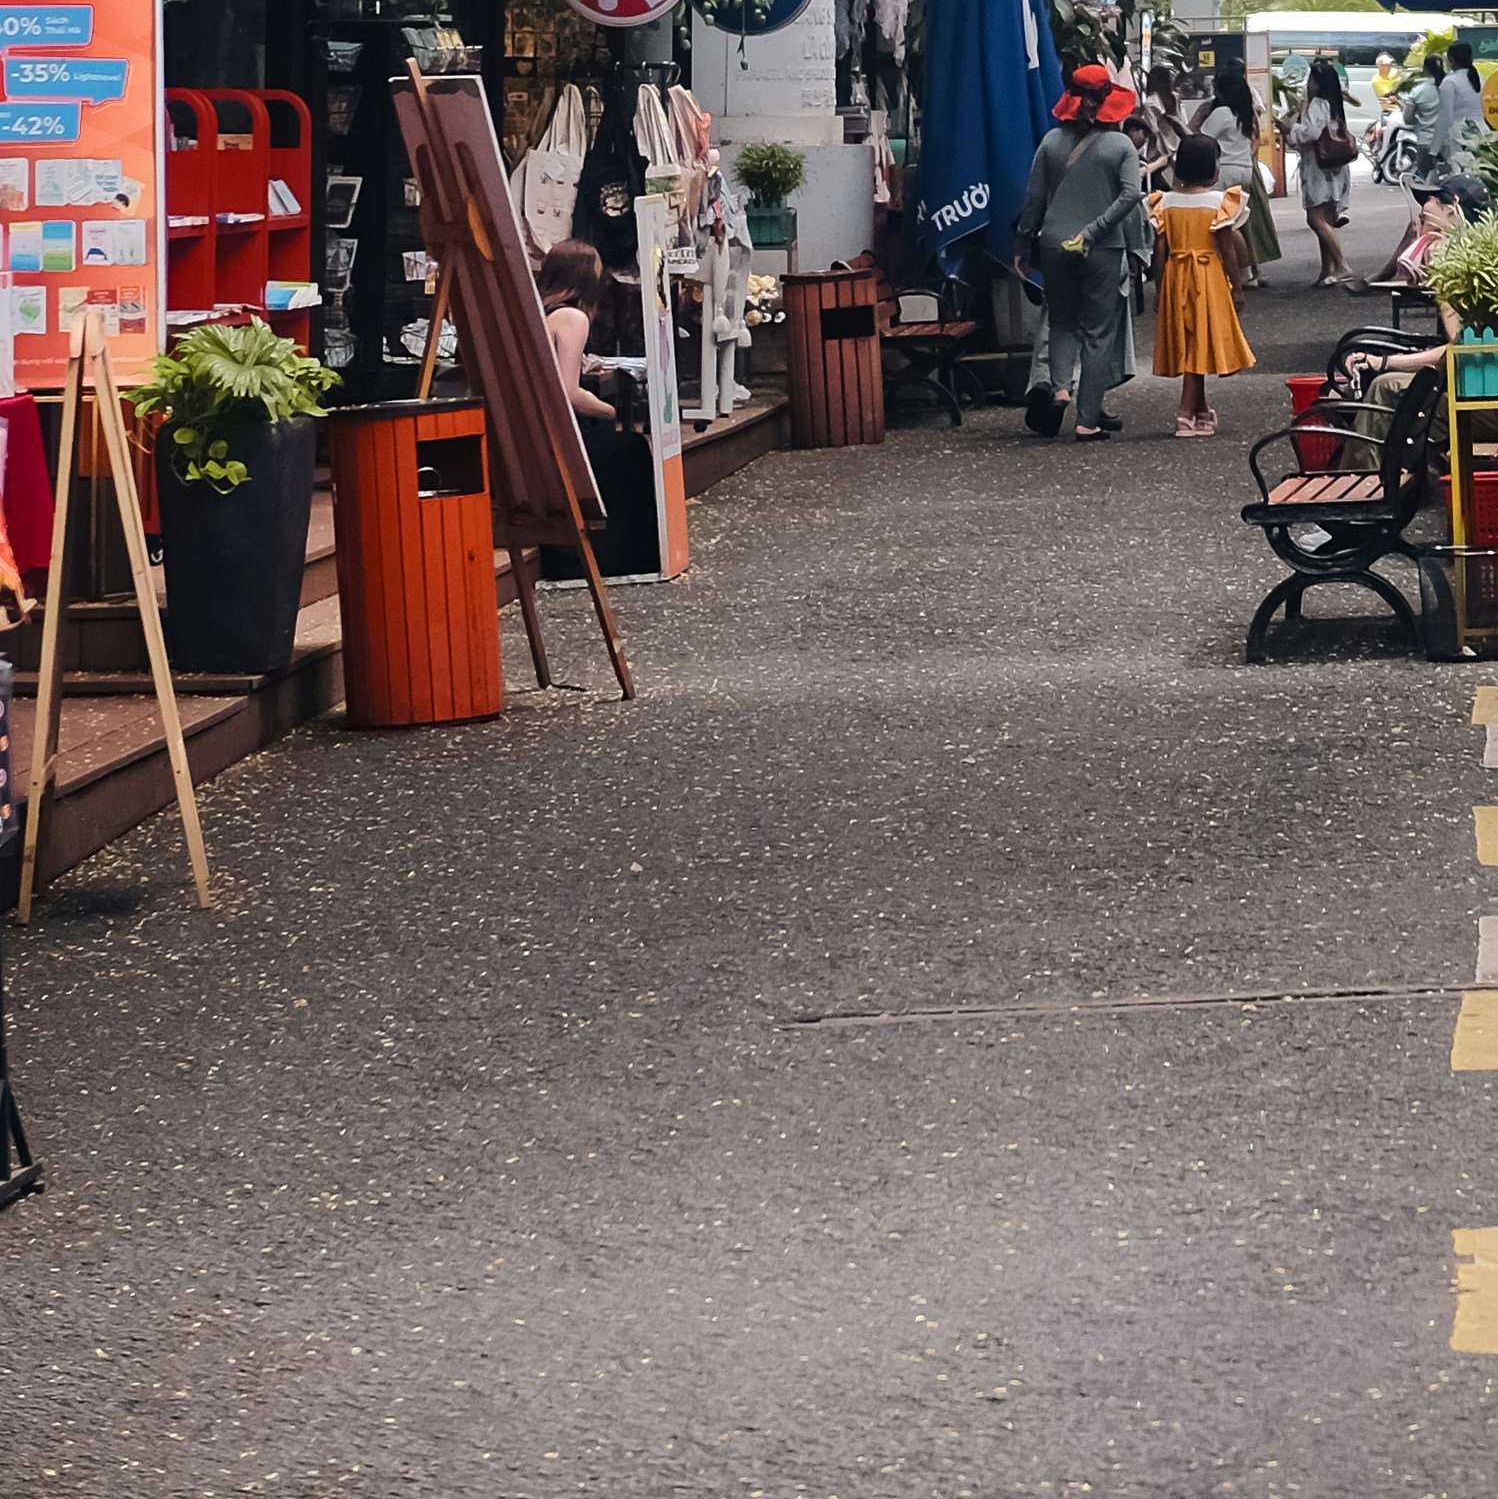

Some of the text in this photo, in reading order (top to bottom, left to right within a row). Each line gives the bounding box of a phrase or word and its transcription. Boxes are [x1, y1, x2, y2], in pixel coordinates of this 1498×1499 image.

[11, 63, 71, 83] -35%
[2, 115, 65, 136] -42%
[930, 182, 991, 232] TRƯỜ
